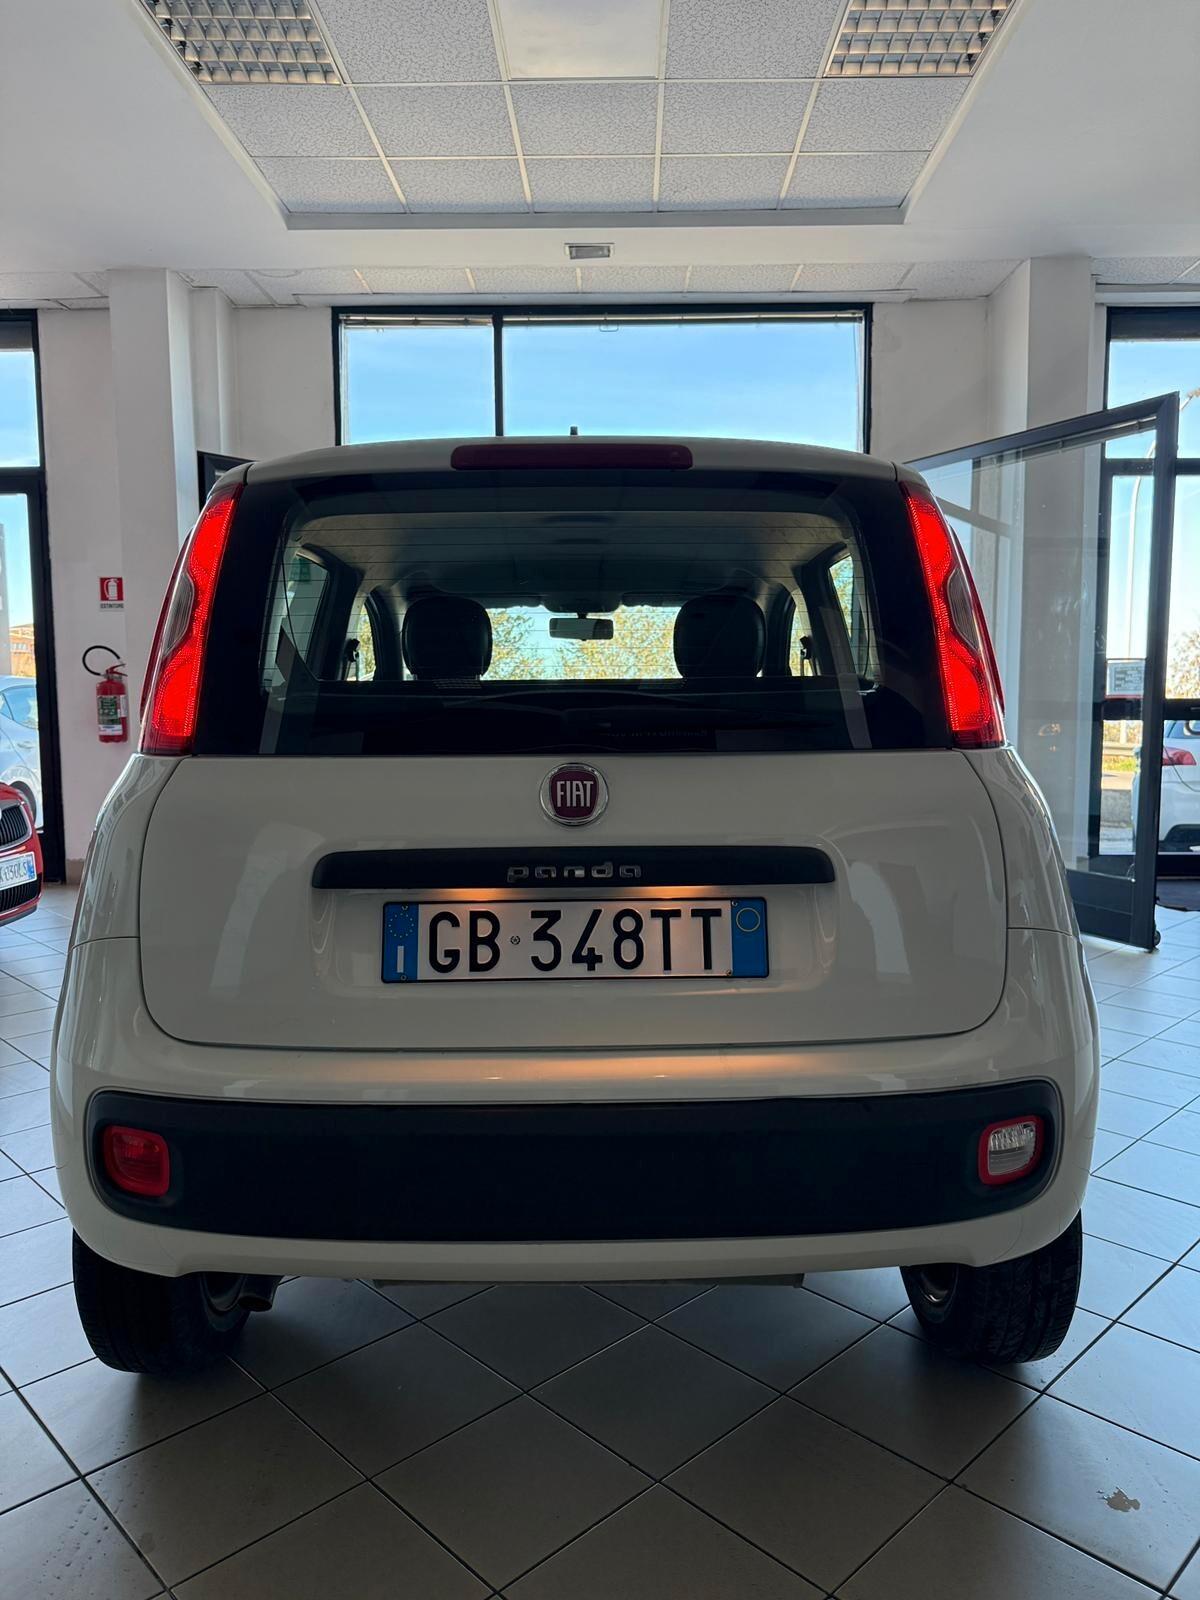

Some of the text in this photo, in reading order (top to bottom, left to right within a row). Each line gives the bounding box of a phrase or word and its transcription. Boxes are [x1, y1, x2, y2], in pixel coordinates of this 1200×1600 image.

[556, 780, 594, 807] FIAT
[507, 861, 641, 883] panda
[428, 910, 501, 974] GB
[530, 907, 722, 972] 348TT
